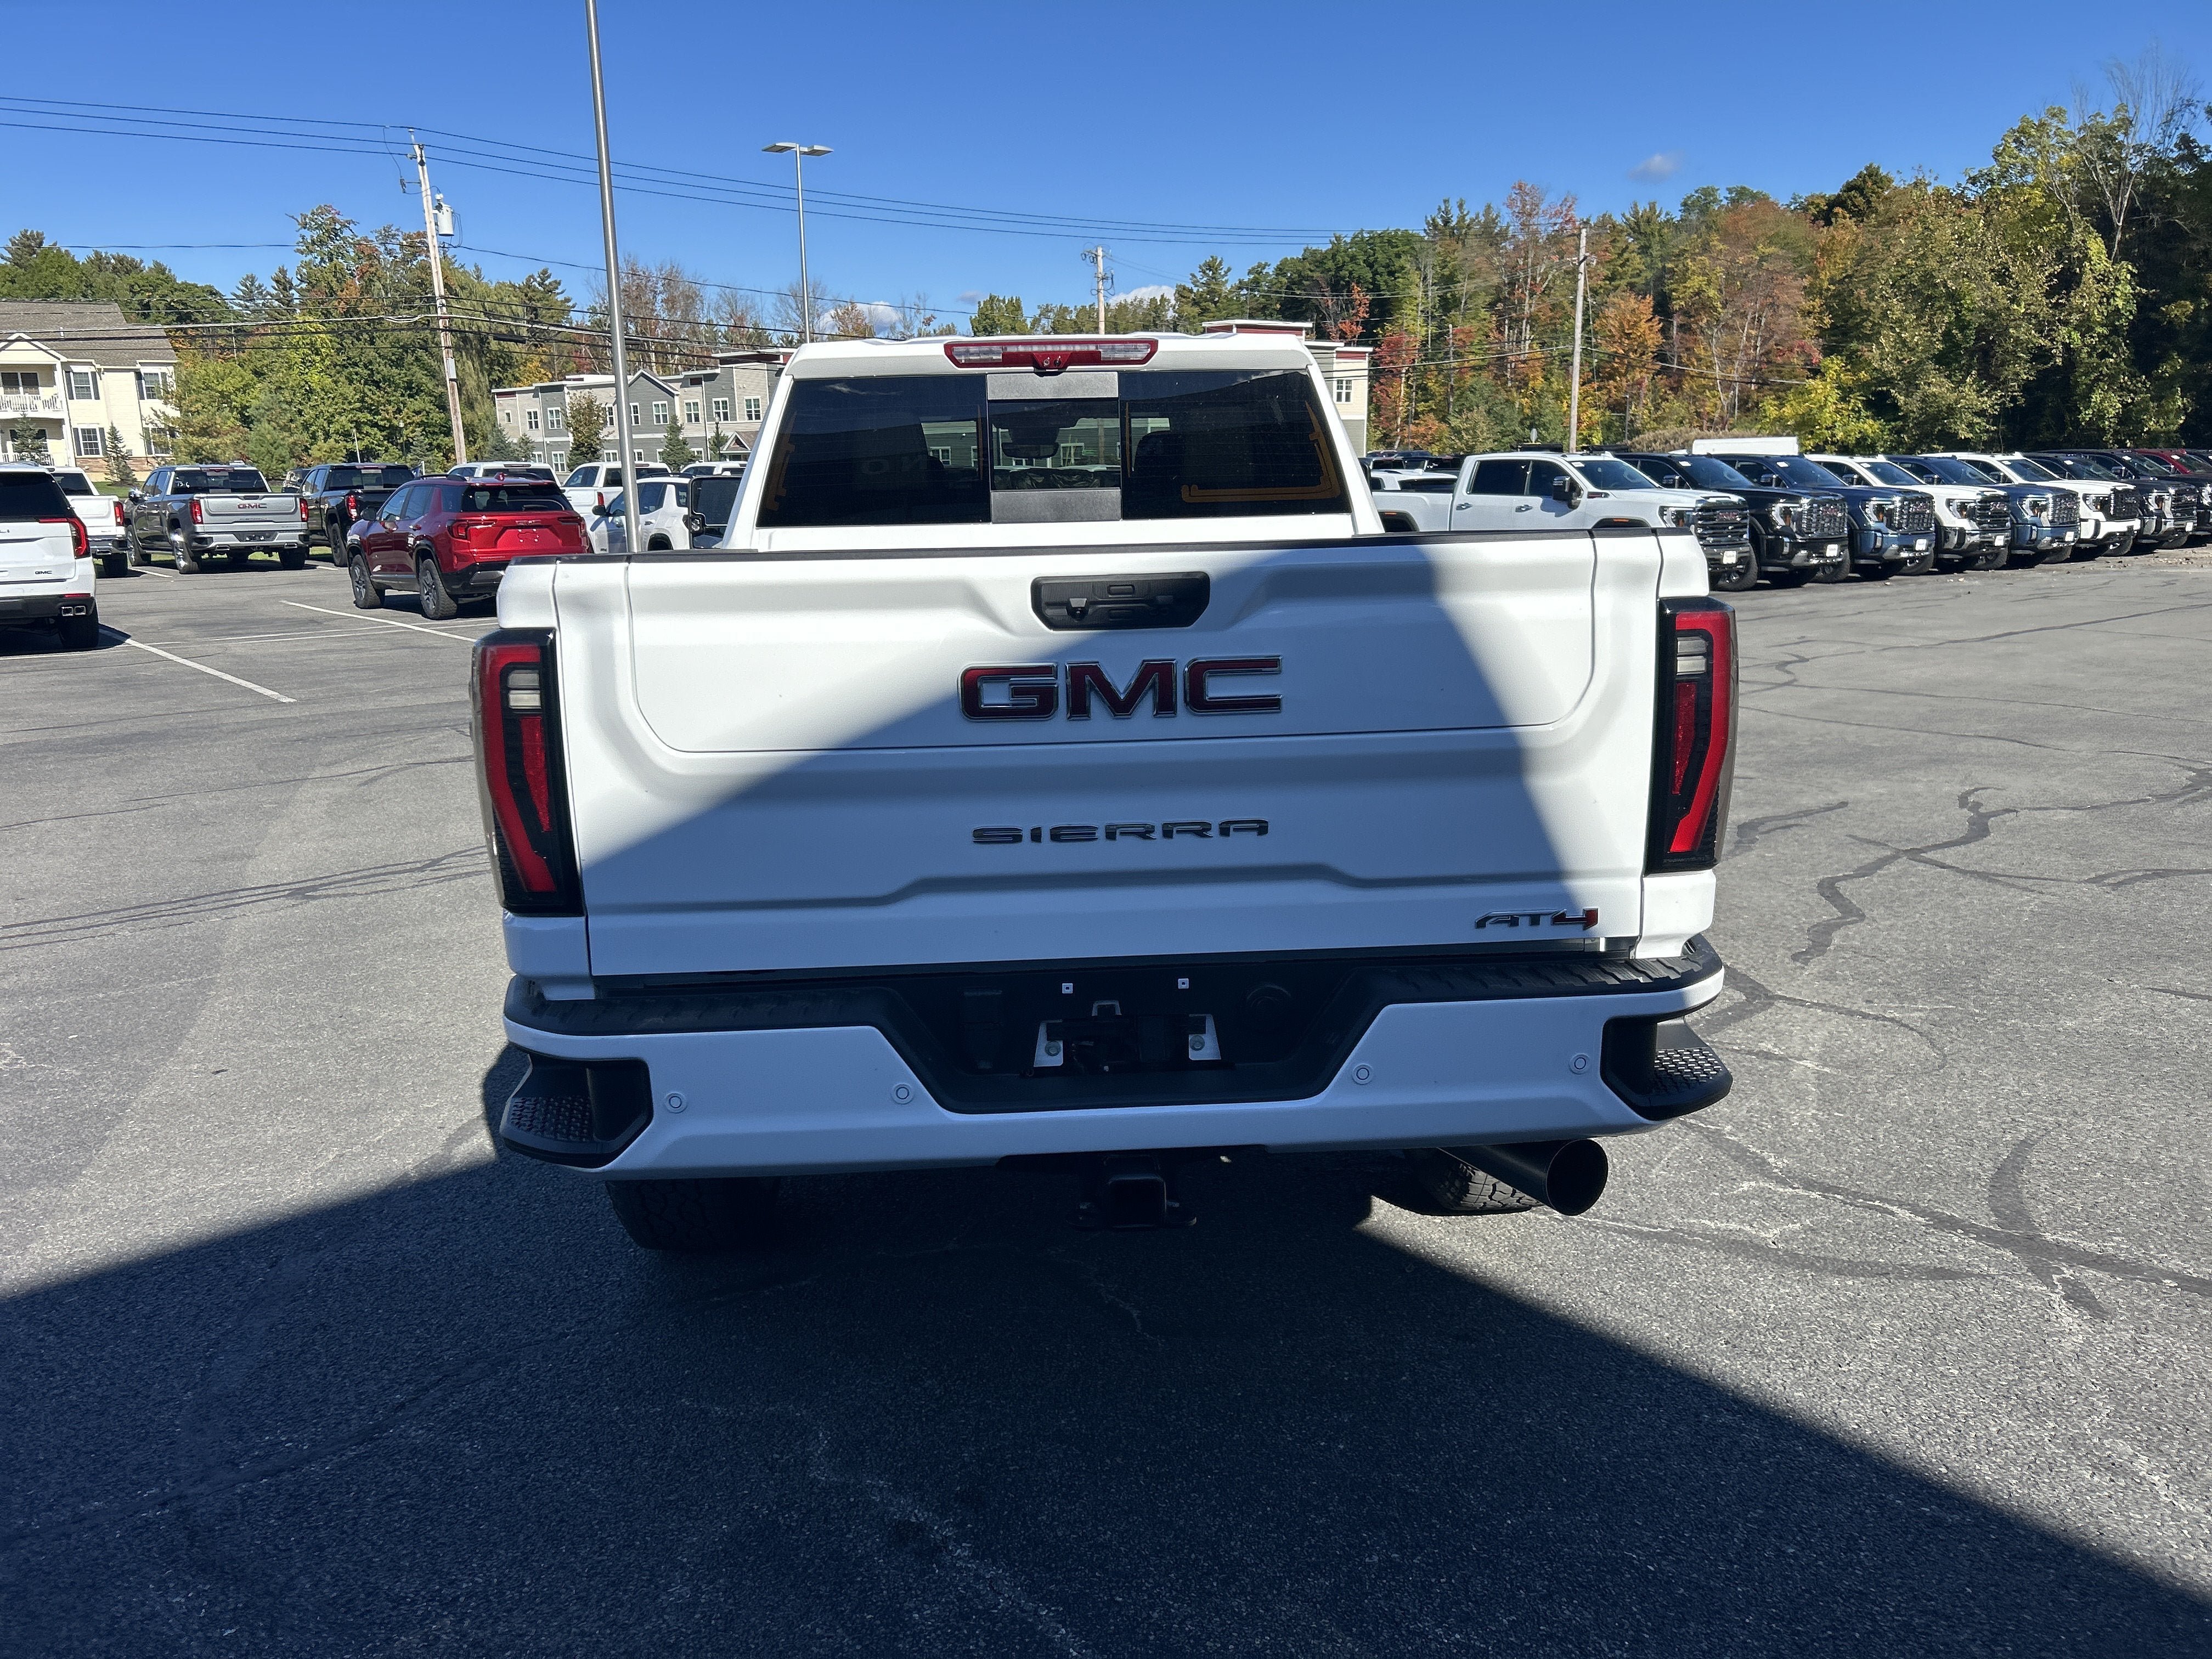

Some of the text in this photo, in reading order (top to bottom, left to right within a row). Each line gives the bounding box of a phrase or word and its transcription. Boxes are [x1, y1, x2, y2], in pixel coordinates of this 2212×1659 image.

[957, 656, 1282, 722] GMC
[972, 818, 1269, 844] SIERRA
[1474, 908, 1599, 930] AT4
